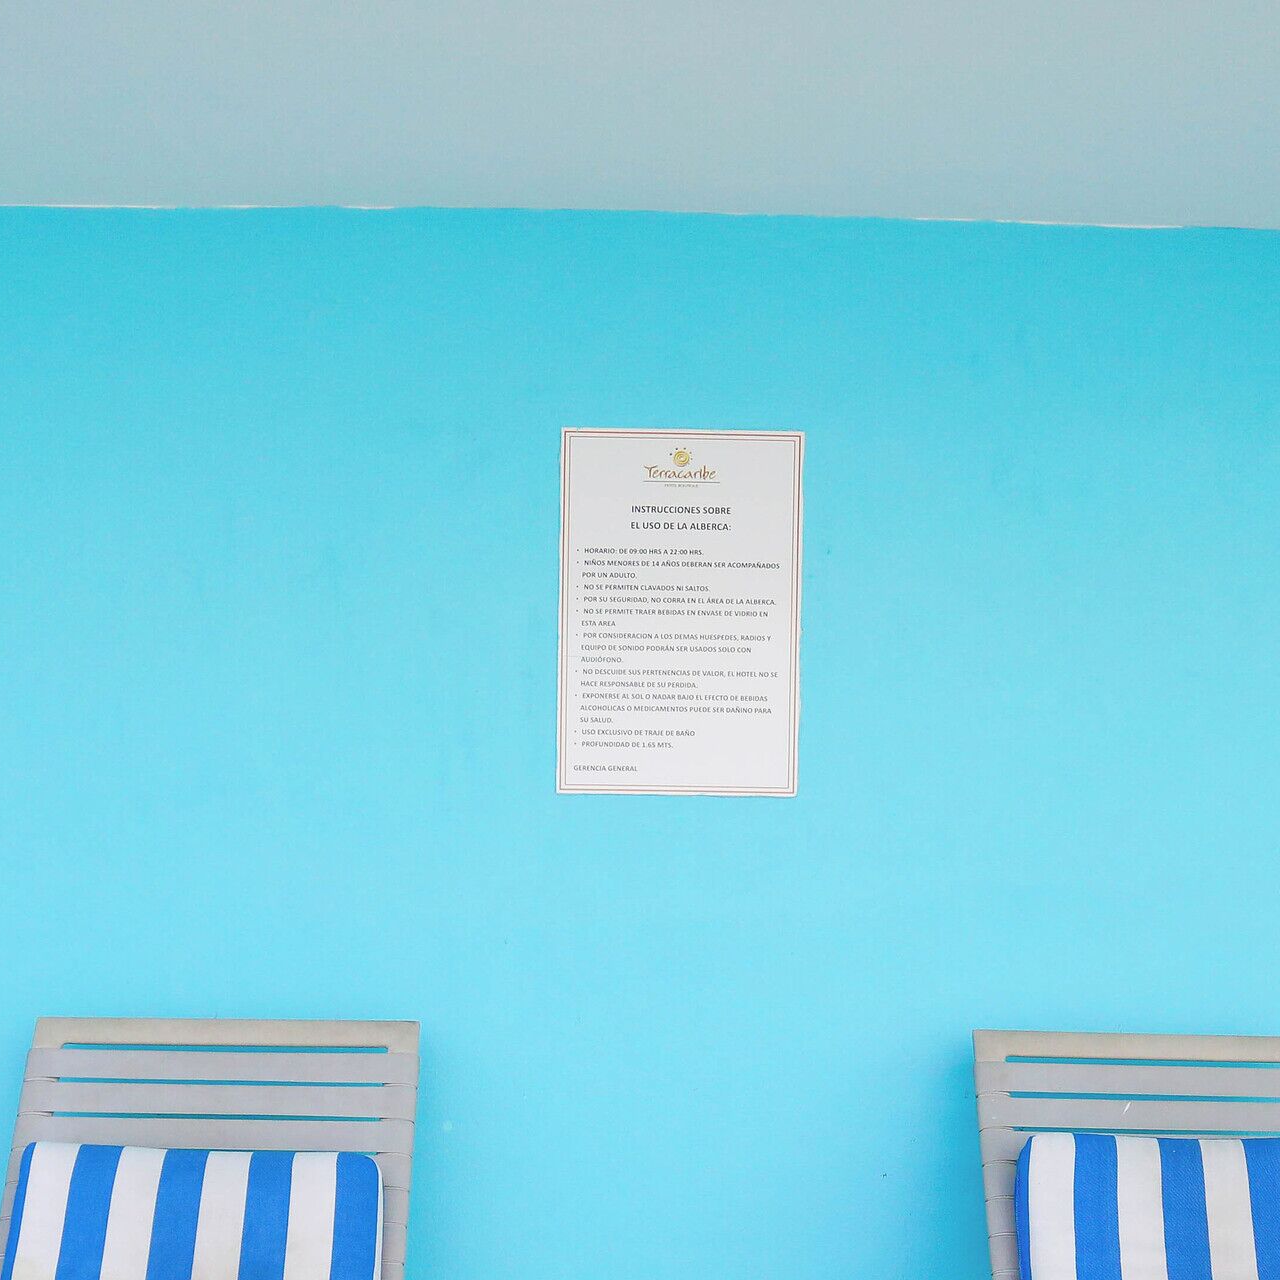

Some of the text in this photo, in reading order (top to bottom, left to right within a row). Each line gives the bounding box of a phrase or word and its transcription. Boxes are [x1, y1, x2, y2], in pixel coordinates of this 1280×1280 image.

[644, 464, 716, 481] Terracaribe
[632, 506, 731, 515] INSTRUCCIONES SOBRE
[631, 522, 731, 531] EL USO DE LA ALBERCA:
[663, 548, 668, 556] A
